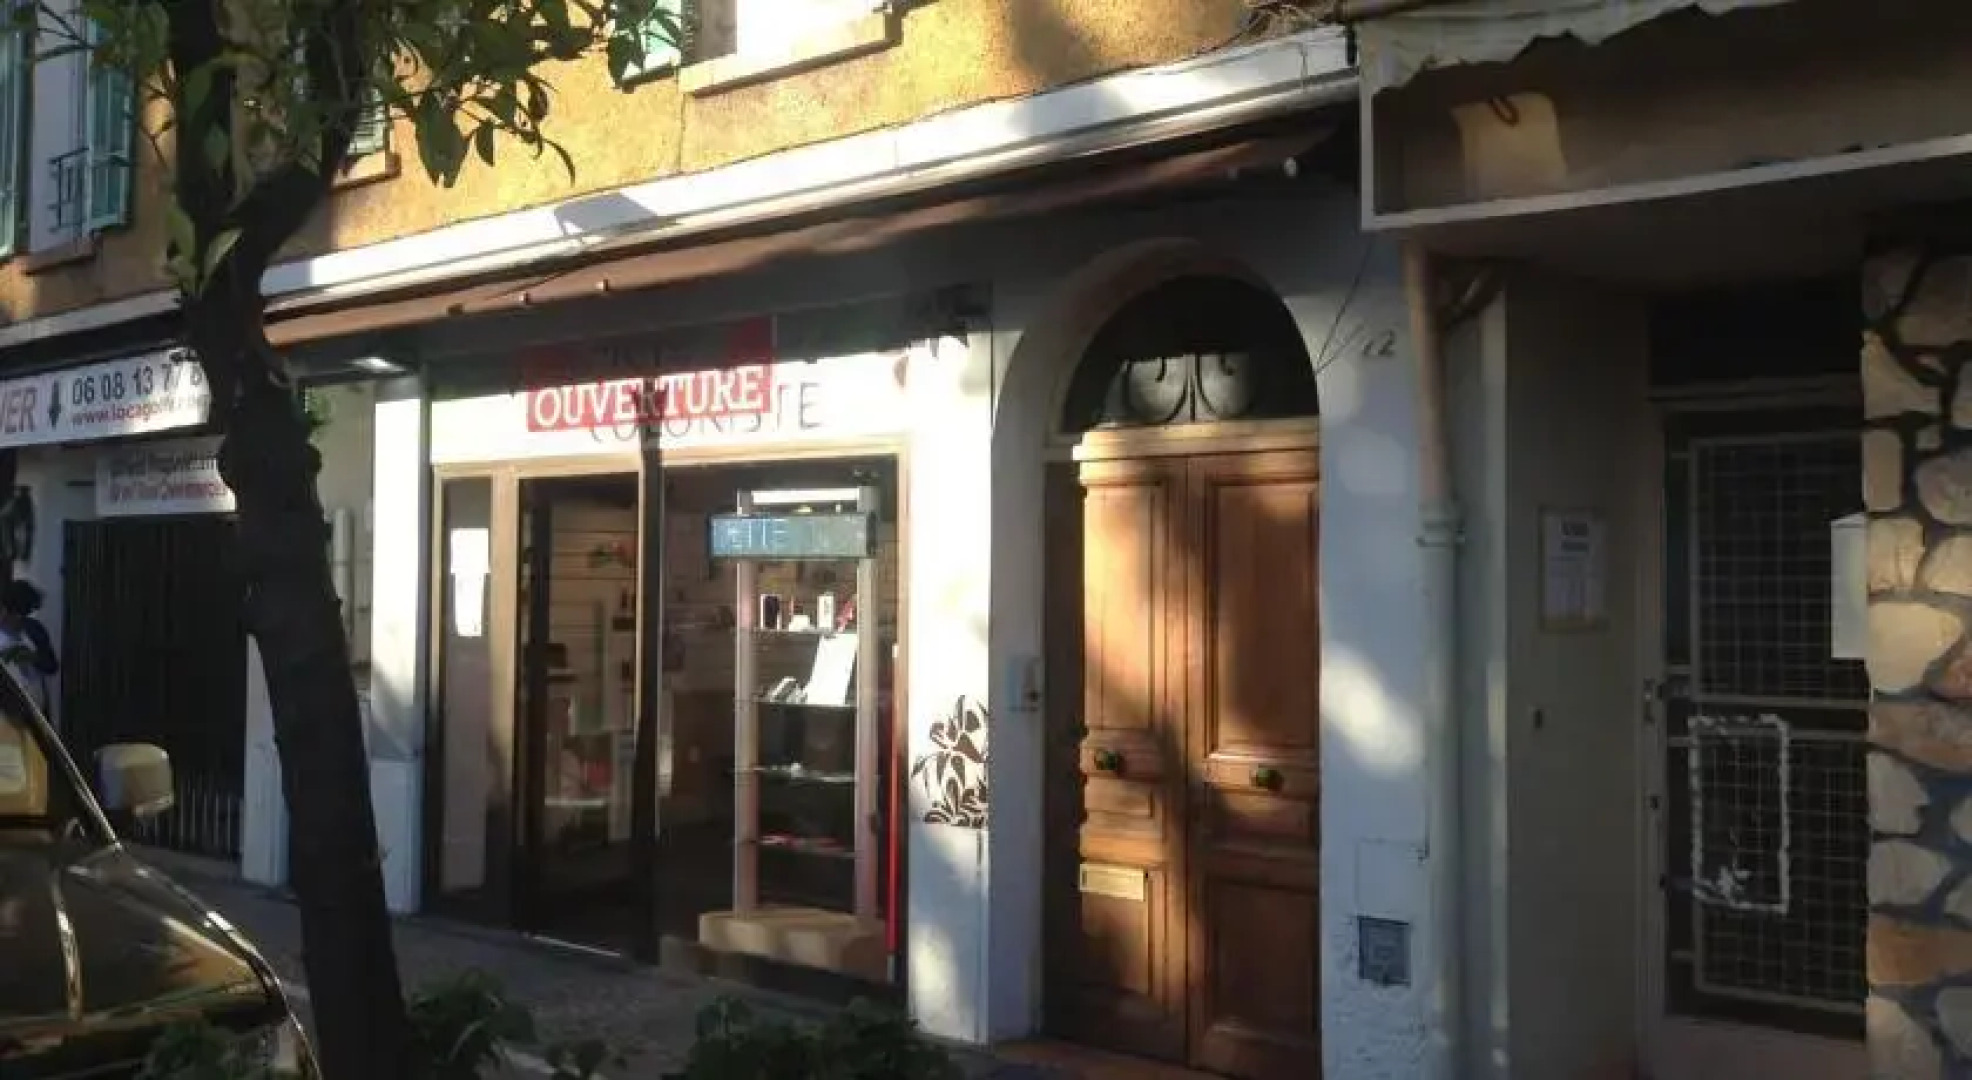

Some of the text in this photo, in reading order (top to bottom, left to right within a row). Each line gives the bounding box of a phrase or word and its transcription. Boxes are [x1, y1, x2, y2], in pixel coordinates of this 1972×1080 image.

[72, 376, 95, 404] 06
[102, 371, 125, 401] 08
[132, 365, 154, 395] 13
[534, 364, 763, 427] OUVERTURE
